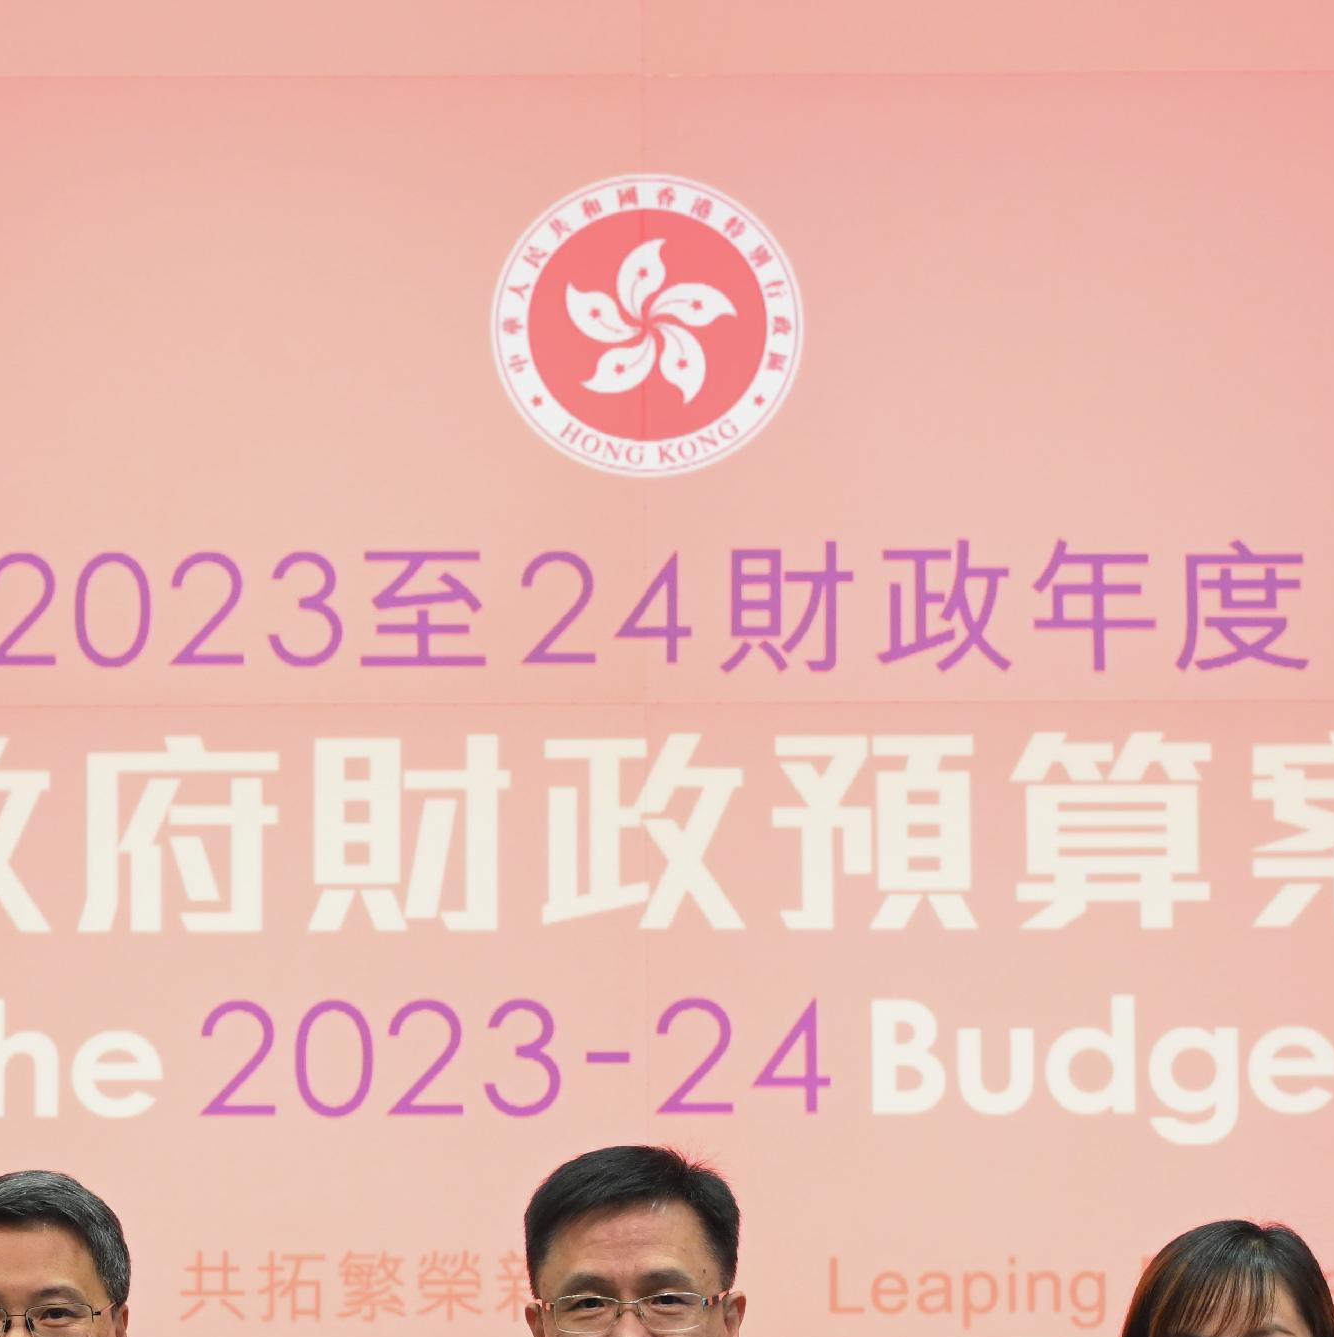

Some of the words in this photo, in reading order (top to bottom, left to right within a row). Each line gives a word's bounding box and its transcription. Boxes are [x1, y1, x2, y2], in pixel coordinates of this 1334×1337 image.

[501, 185, 791, 374] 中華人民共和國香港特別行政區
[558, 420, 647, 465] HONG
[657, 418, 740, 465] KONG
[199, 998, 833, 1116] 2023-24
[828, 1256, 1106, 1329] Leaping
